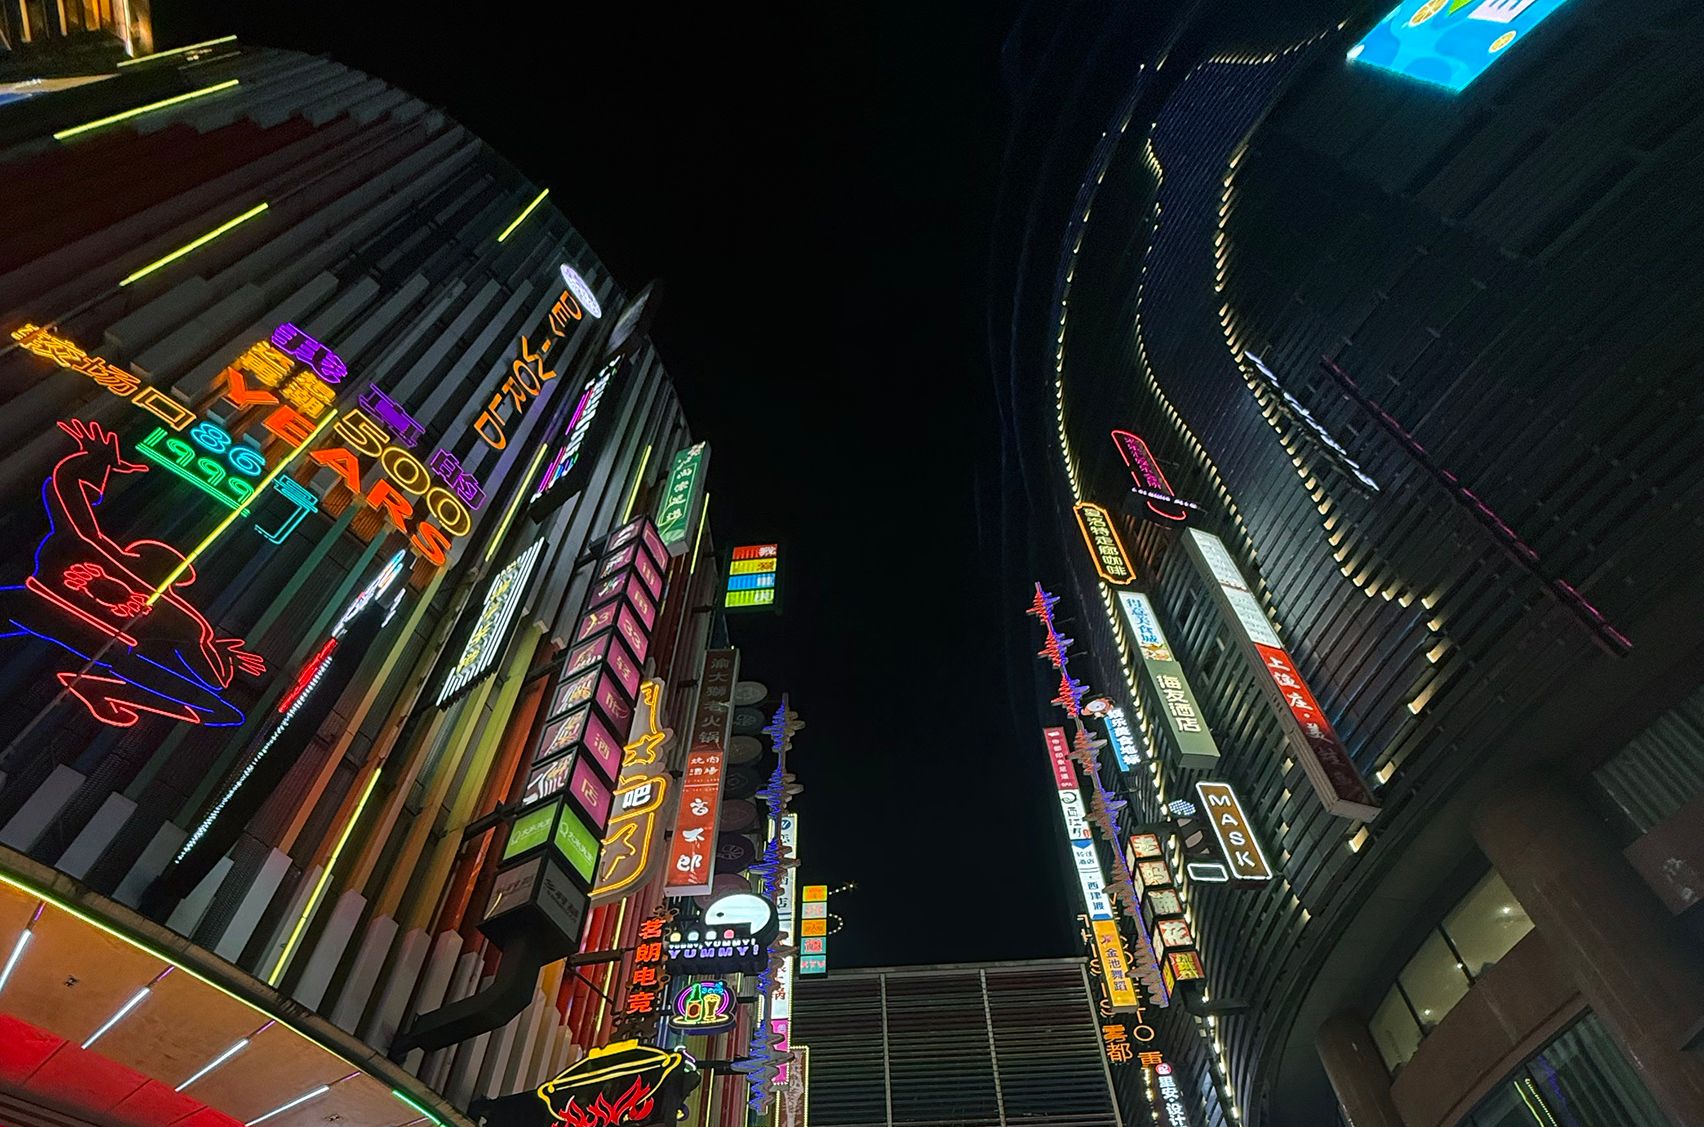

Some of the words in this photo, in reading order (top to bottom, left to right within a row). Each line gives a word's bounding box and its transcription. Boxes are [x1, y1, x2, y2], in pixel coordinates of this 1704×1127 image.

[136, 427, 255, 503] 1999
[226, 367, 453, 566] YEARS
[334, 408, 473, 537] 500
[1156, 674, 1202, 732] 海友酒店
[1207, 794, 1256, 868] MASK
[668, 944, 759, 959] YUMMY!
